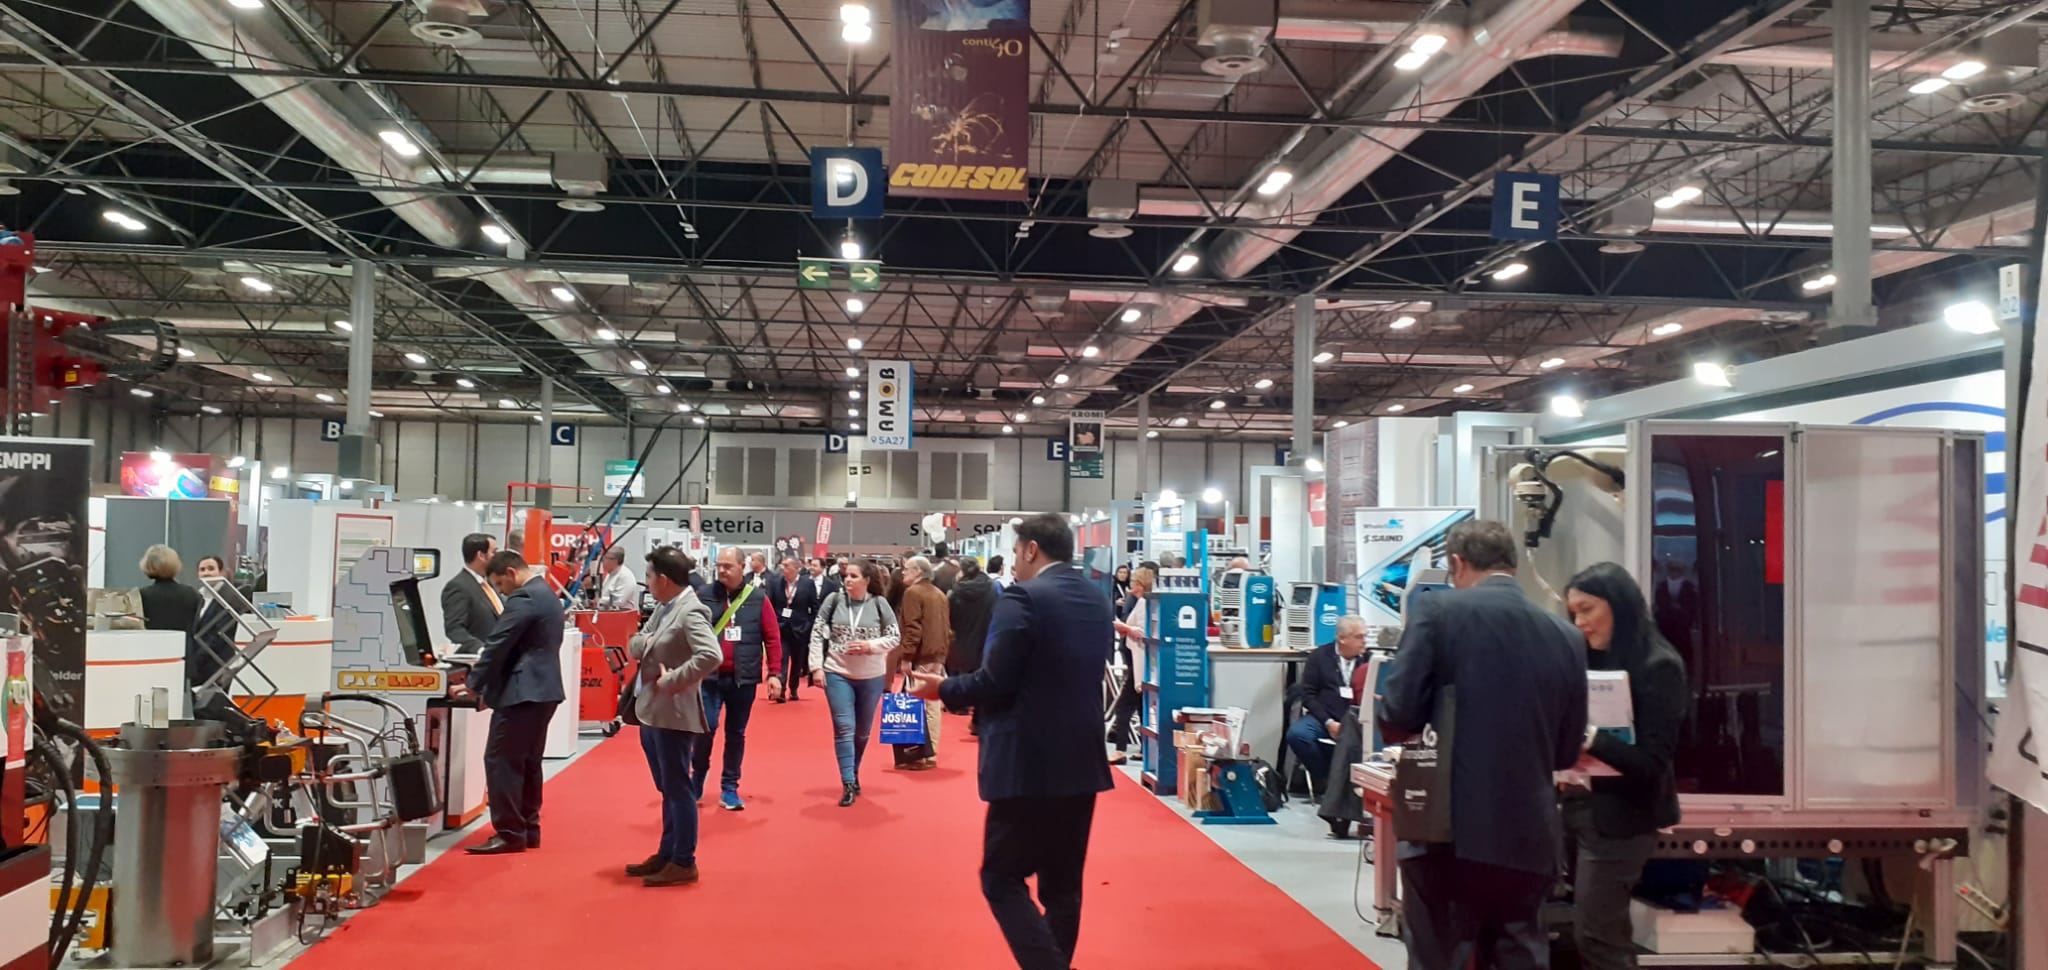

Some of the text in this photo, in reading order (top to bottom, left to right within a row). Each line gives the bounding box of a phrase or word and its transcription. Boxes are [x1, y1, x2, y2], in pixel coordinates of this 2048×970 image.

[826, 158, 868, 207] D
[889, 163, 1026, 191] CODESOL
[1510, 182, 1541, 230] E
[879, 367, 895, 431] AMOB
[327, 421, 340, 438] B
[556, 426, 571, 443] C
[829, 435, 844, 450] D
[1053, 442, 1064, 458] E
[678, 516, 764, 534] aetería
[50, 671, 82, 681] elder
